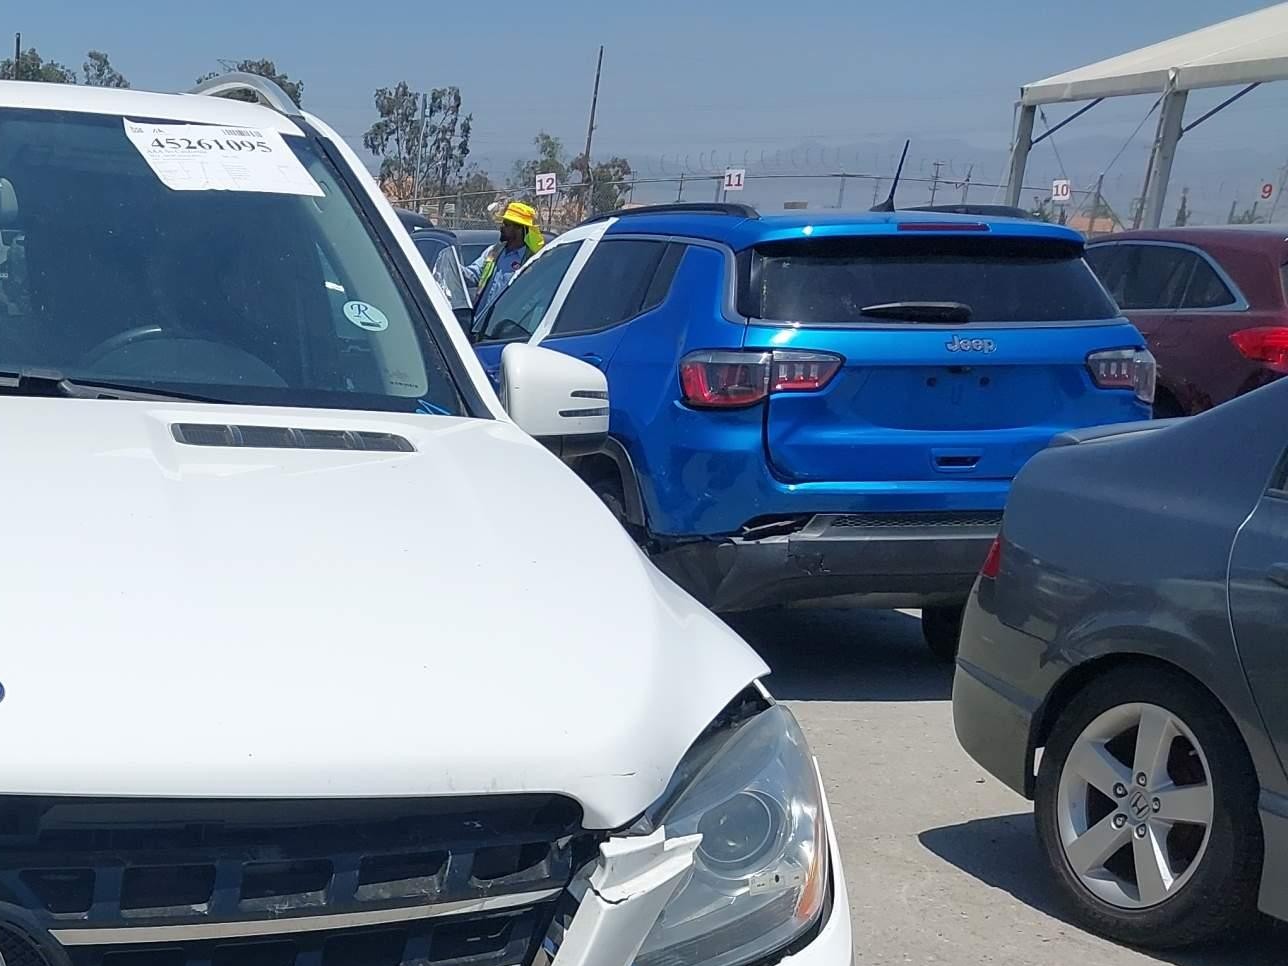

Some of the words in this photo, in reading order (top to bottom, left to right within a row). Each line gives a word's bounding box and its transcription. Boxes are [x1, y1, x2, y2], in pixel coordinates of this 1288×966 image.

[150, 138, 273, 153] 45261095
[537, 178, 555, 192] 12
[725, 173, 743, 187] 11
[1054, 184, 1069, 197] 10
[1261, 183, 1273, 199] 9
[945, 335, 998, 355] Jeep
